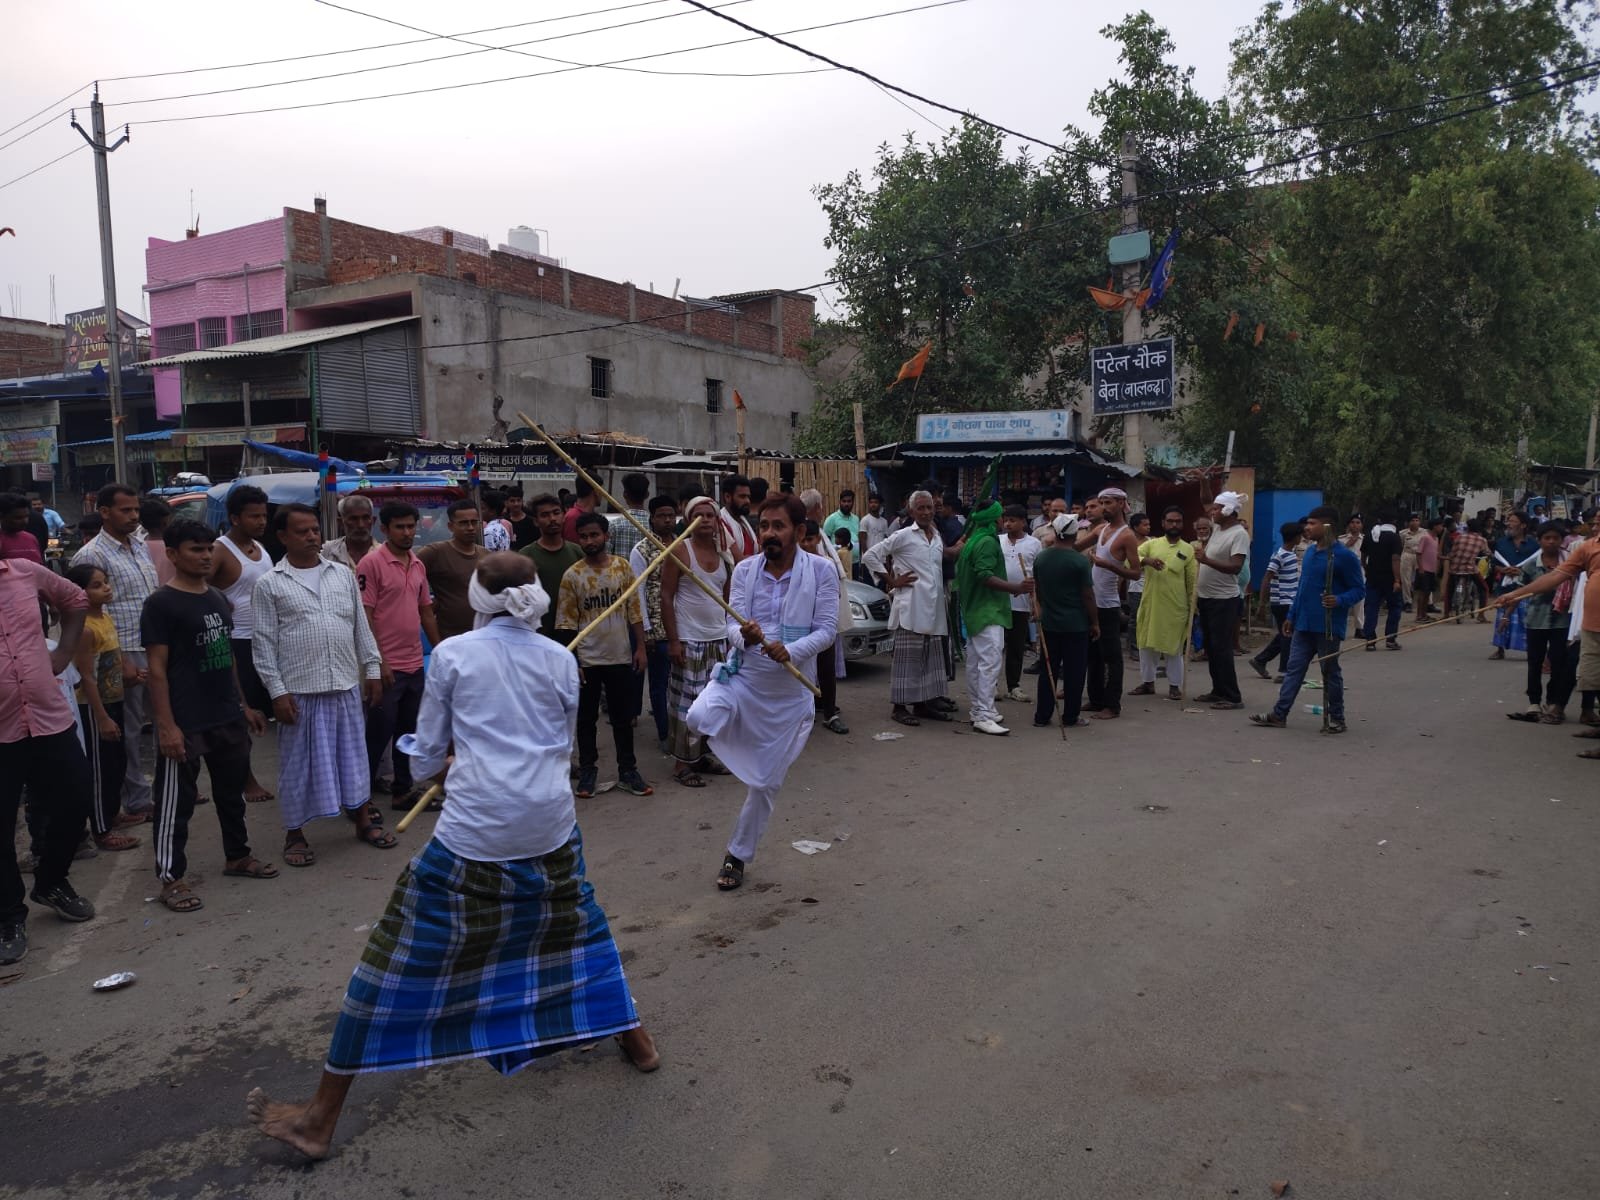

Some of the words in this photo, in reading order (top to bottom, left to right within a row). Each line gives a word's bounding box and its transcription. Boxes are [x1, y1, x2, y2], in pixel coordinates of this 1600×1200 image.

[72, 312, 107, 336] Reviva
[1094, 352, 1130, 374] पटेल
[1132, 345, 1167, 369] चौक
[1098, 379, 1119, 402] बेन
